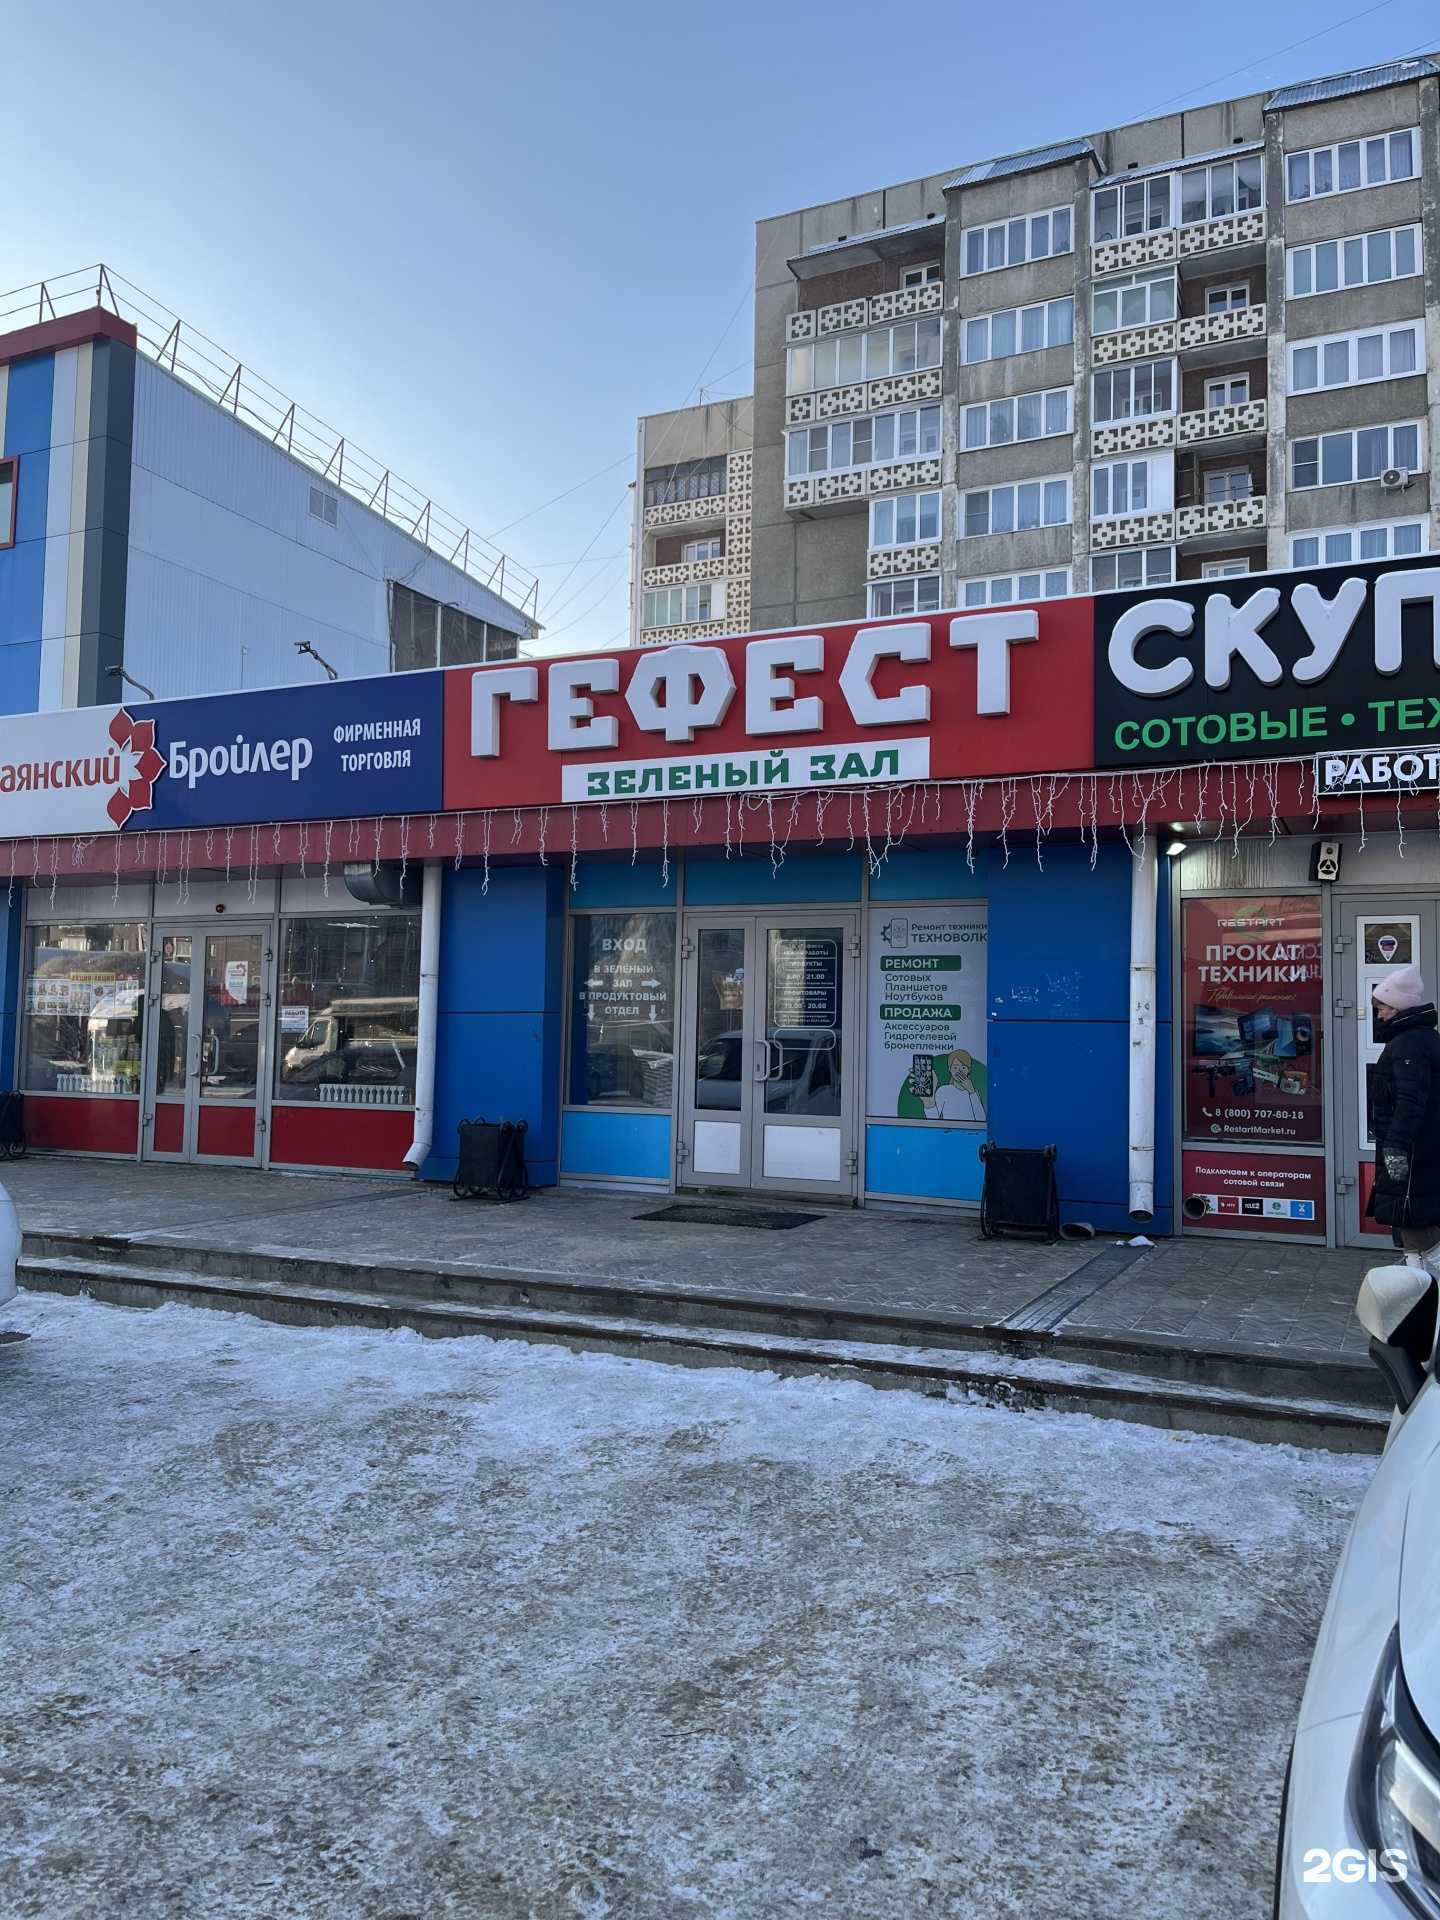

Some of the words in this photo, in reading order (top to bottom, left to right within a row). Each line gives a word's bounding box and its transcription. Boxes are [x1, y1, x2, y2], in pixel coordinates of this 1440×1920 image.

[1108, 567, 1440, 698] СКУП
[471, 609, 1039, 758] ГЕФЕСТ
[1114, 706, 1328, 750] СОТОВЫЕ
[1367, 697, 1440, 732] ТЕХ
[333, 718, 421, 744] ФИРМЕННАЯ
[169, 734, 313, 788] Бройлер
[341, 749, 411, 772] ТОРГОВЛЯ
[587, 750, 790, 796] ЗЕЛЕНЫЙ
[810, 749, 899, 782] ЗАЛ
[602, 938, 647, 953] ВХОД
[1206, 943, 1299, 962] ПРОКАТ
[885, 958, 939, 969] РЕМОНТ
[885, 973, 931, 982] Сотовых
[1198, 965, 1307, 983] ТЕХНИКИ
[885, 983, 947, 992] Планшетов
[589, 991, 667, 1002] ПРОДУКТОВЫЙ
[885, 992, 944, 1002] Ноутбуков
[604, 1006, 640, 1016] ОТДЕЛ
[884, 1007, 953, 1019] ПРОДАЖА
[884, 1022, 950, 1033] Аксессуаров
[884, 1032, 957, 1043] Гидрогелевой
[1215, 1108, 1222, 1117] 8
[1224, 1108, 1251, 1119] (800)
[1223, 1125, 1296, 1136] RestartMarket.ru
[1195, 1166, 1248, 1177] Подключаем
[1257, 1171, 1312, 1180] операторам
[1223, 1178, 1258, 1187] сотовой
[1260, 1180, 1285, 1188] связи
